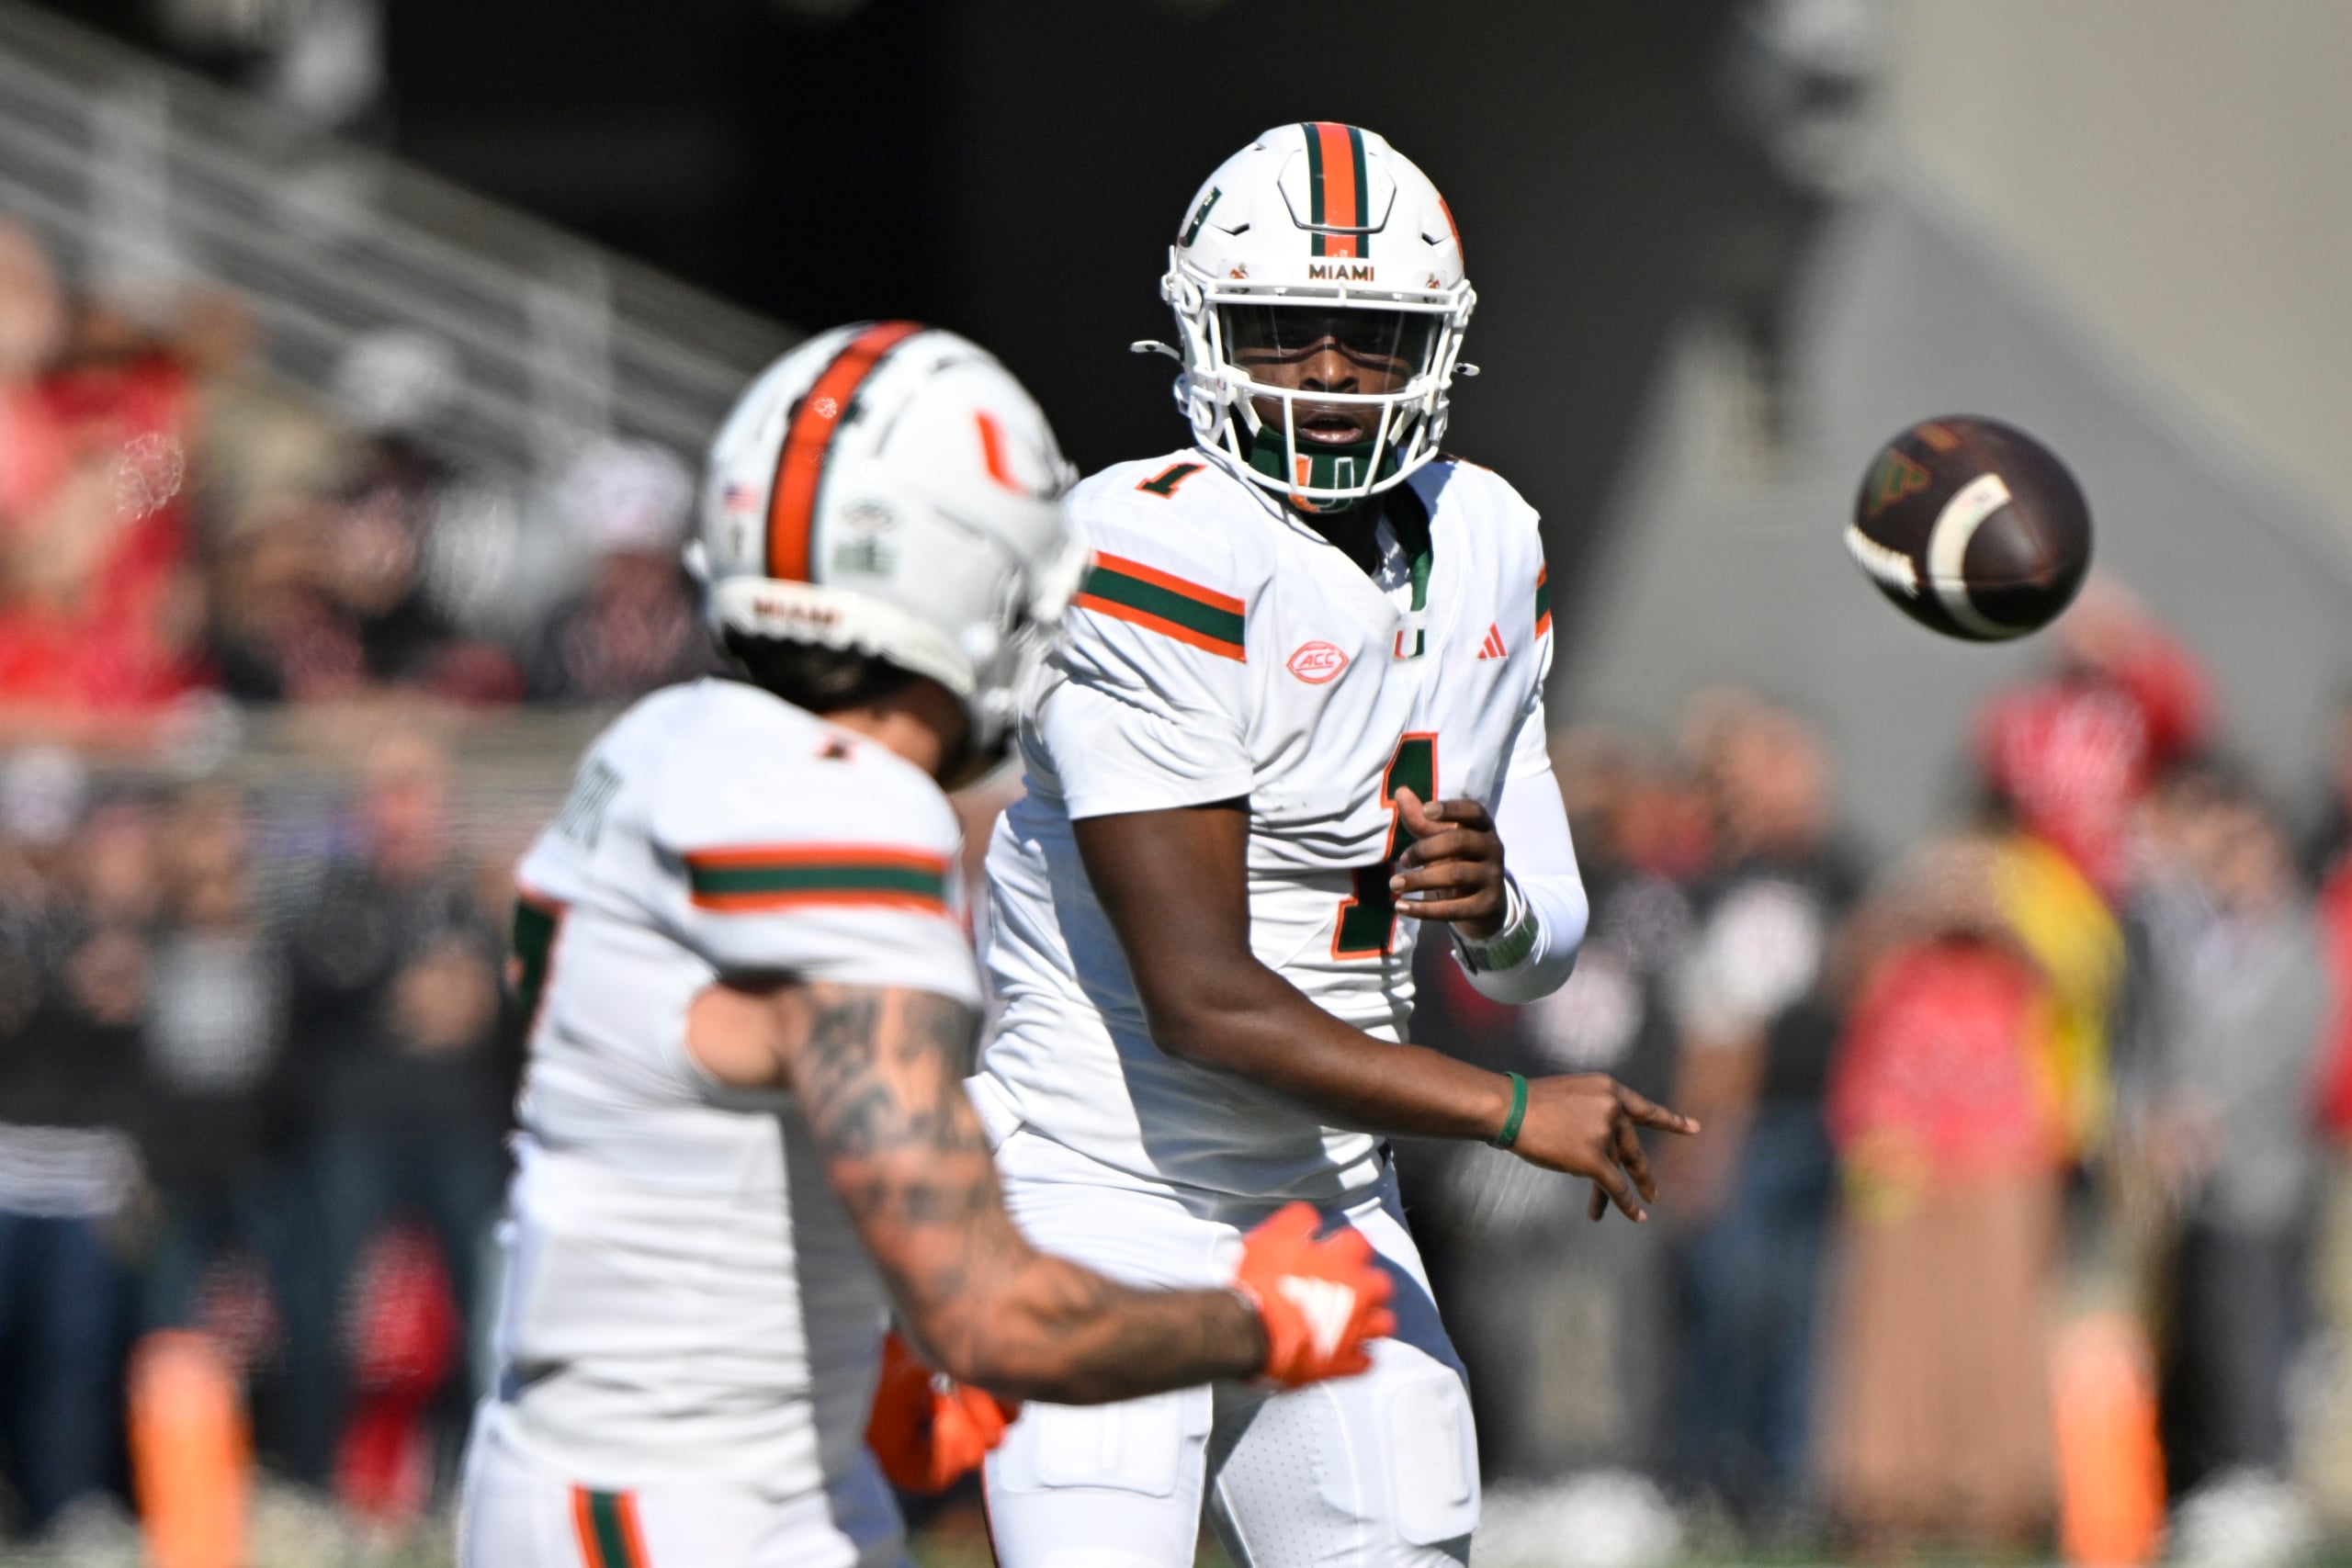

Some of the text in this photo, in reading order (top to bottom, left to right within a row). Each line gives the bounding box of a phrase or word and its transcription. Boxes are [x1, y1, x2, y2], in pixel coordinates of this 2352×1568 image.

[1309, 264, 1374, 281] MIAMI
[1135, 462, 1207, 500] 1
[1394, 629, 1425, 660] U
[1296, 653, 1336, 668] ACC
[1331, 732, 1440, 960] 1
